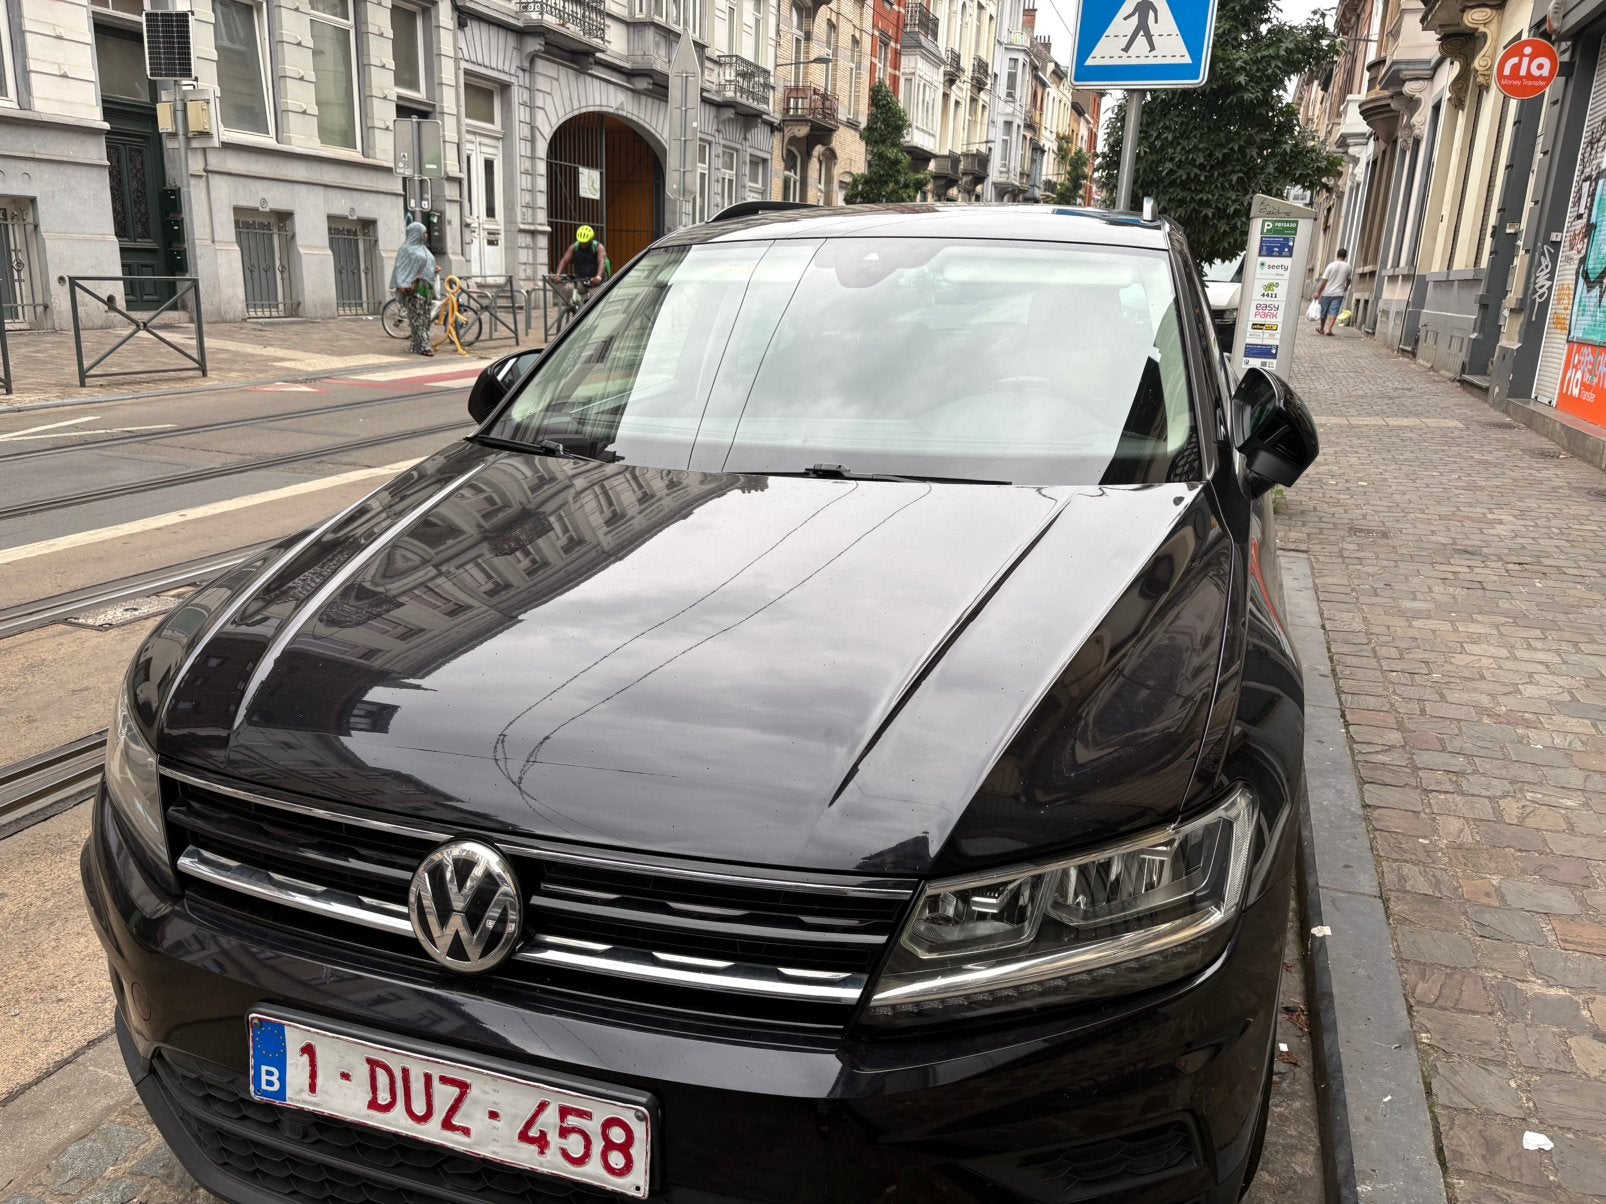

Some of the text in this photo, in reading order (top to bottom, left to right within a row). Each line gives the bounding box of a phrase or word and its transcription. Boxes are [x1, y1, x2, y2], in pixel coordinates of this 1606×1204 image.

[1503, 46, 1551, 77] ria
[1500, 78, 1547, 87] Money Transfer
[1264, 221, 1273, 233] P
[1267, 264, 1289, 272] seety
[1255, 303, 1280, 312] easy
[1563, 354, 1582, 398] ria
[260, 1064, 281, 1092] B
